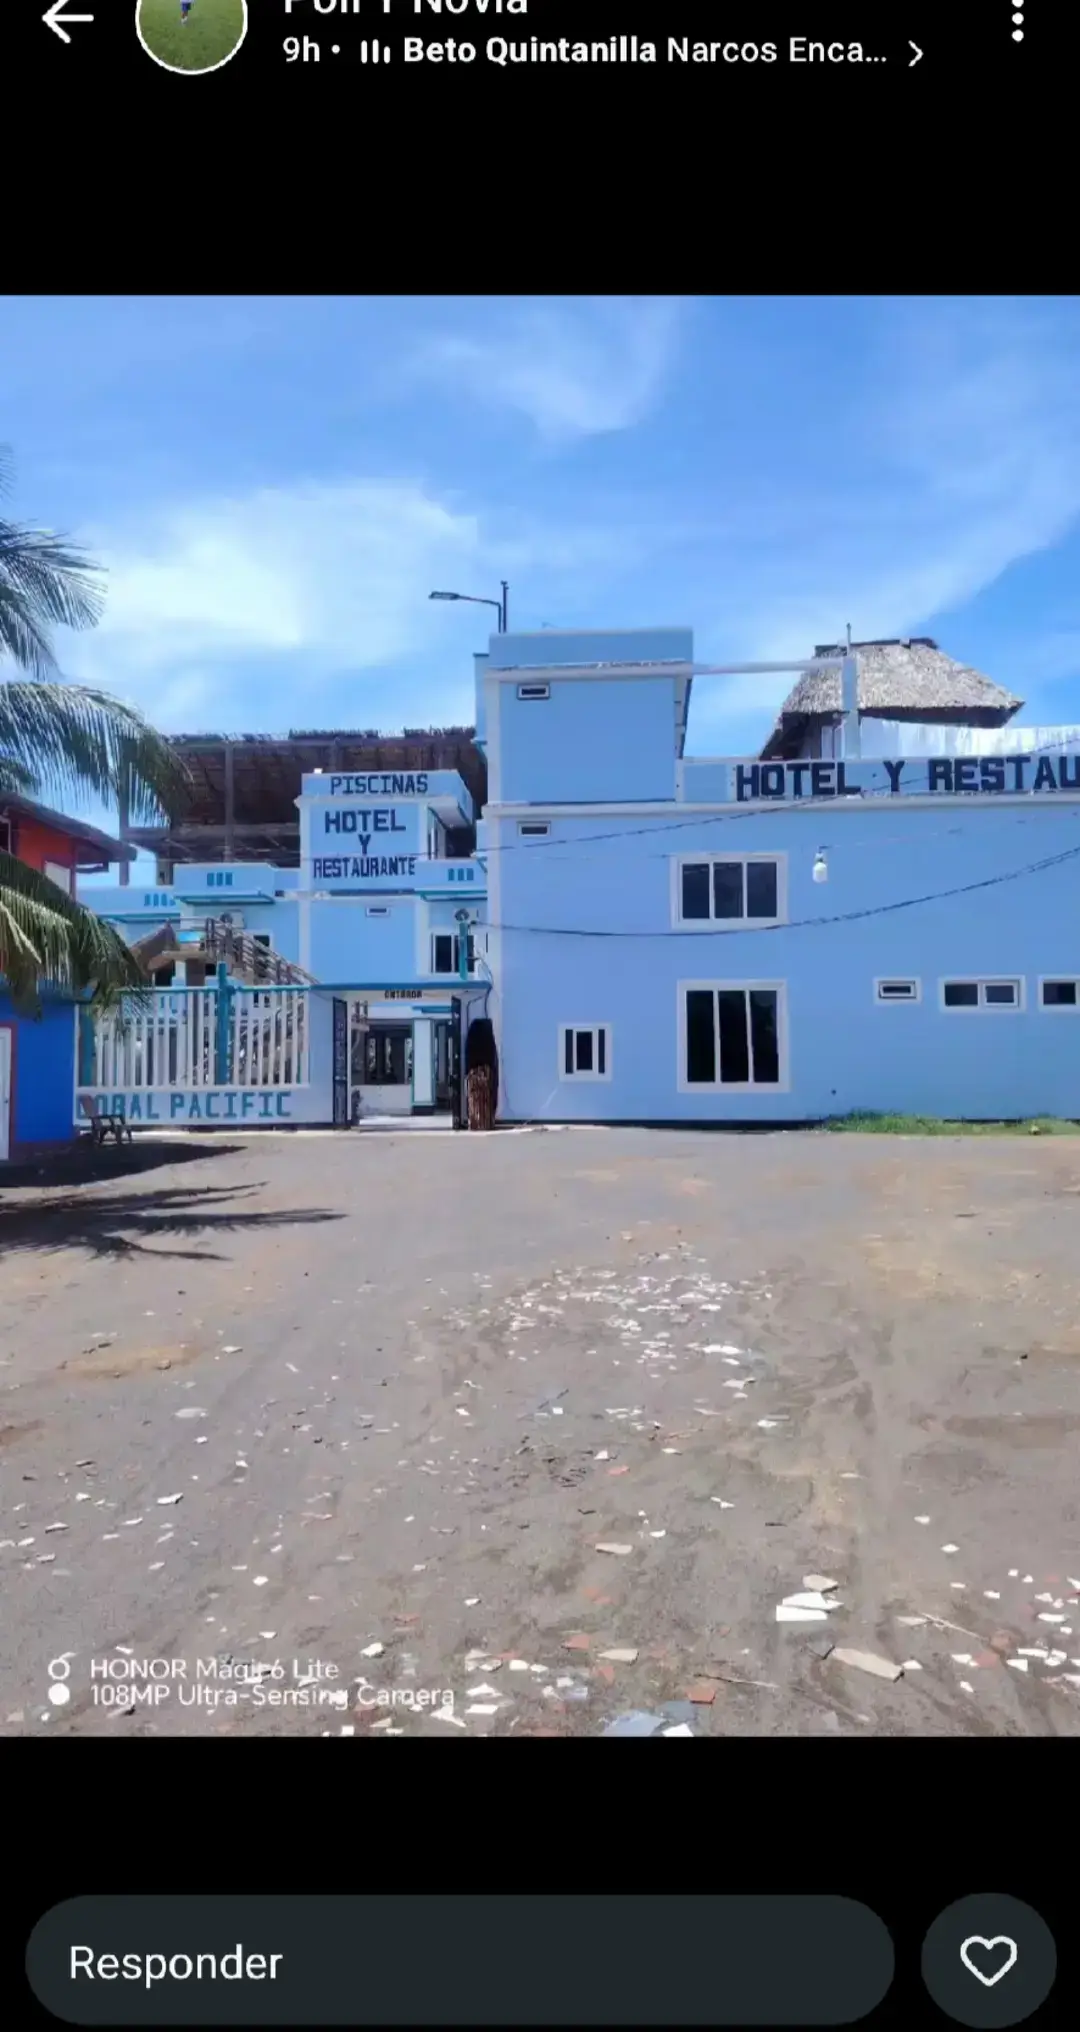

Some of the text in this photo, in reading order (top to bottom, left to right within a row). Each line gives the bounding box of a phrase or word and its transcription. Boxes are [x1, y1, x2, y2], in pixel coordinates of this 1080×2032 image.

[330, 774, 428, 795] PISCINAS
[736, 755, 1080, 801] HOTEL Y RESTAU
[325, 809, 406, 833] HOTEL
[358, 834, 371, 855] Y
[313, 857, 416, 878] RESTAURANTE
[170, 1091, 292, 1119] PACIFIC
